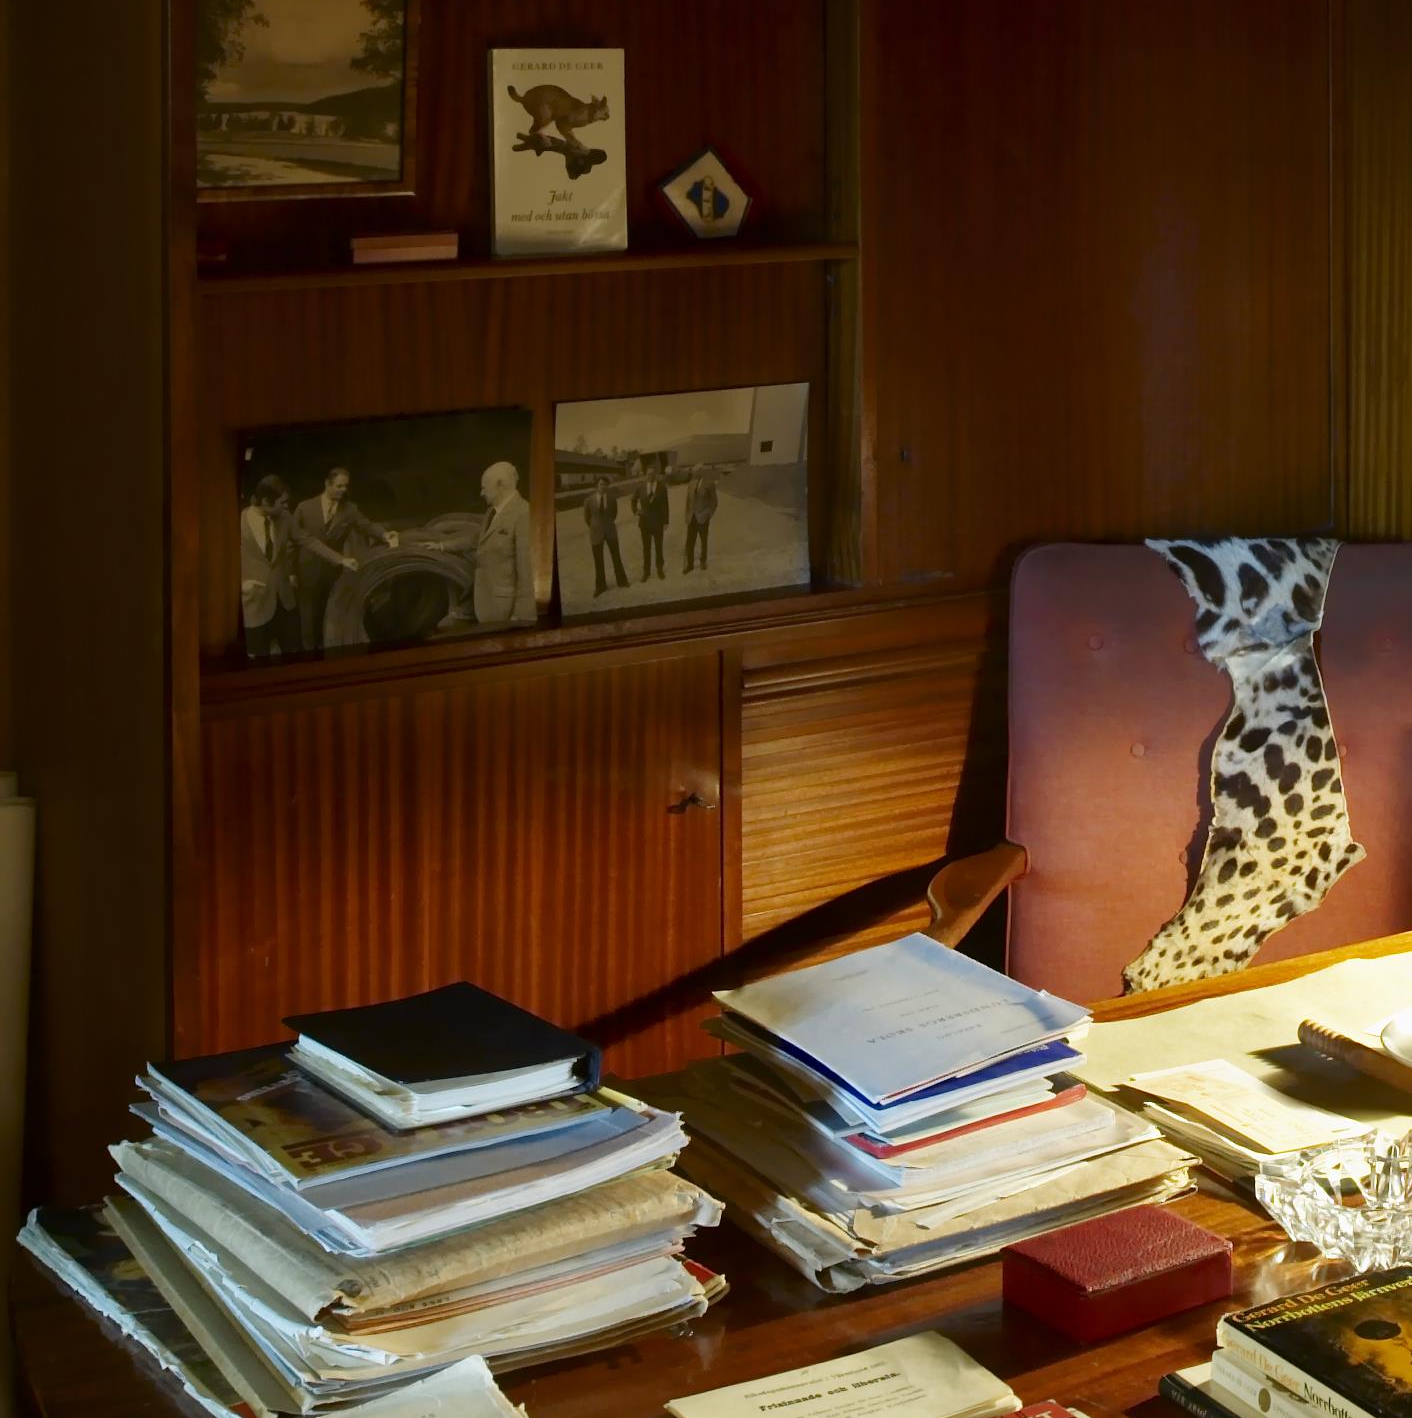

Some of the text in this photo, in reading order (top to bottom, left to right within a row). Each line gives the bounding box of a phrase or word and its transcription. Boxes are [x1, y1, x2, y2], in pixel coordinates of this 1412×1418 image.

[547, 190, 574, 206] Jakt
[511, 209, 534, 221] med
[555, 211, 579, 221] utan
[1232, 1278, 1370, 1324] Gerard De Geer
[1245, 1294, 1354, 1331] Norrbottens
